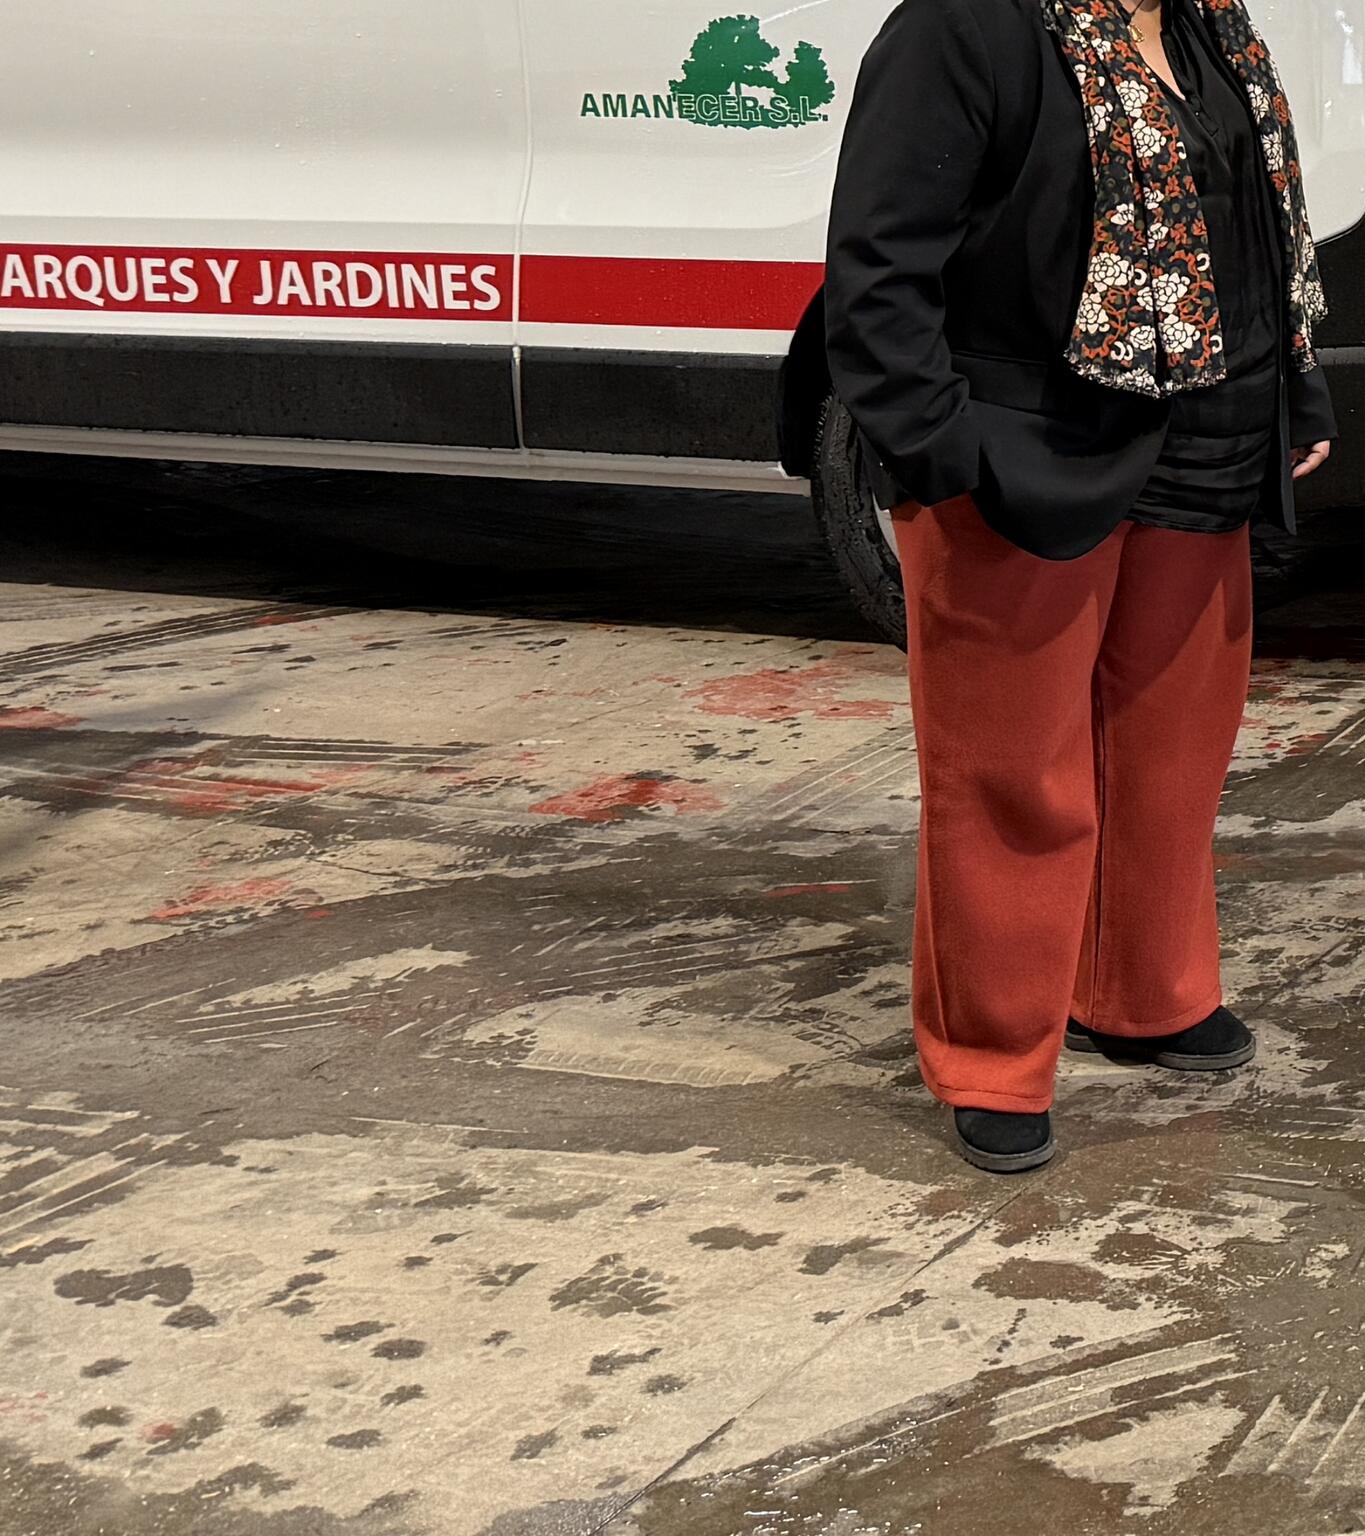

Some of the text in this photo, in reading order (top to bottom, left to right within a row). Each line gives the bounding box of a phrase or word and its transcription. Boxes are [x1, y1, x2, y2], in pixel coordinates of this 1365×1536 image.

[580, 93, 762, 122] AMANECER
[205, 259, 239, 304] Y
[252, 260, 501, 311] JARDINES
